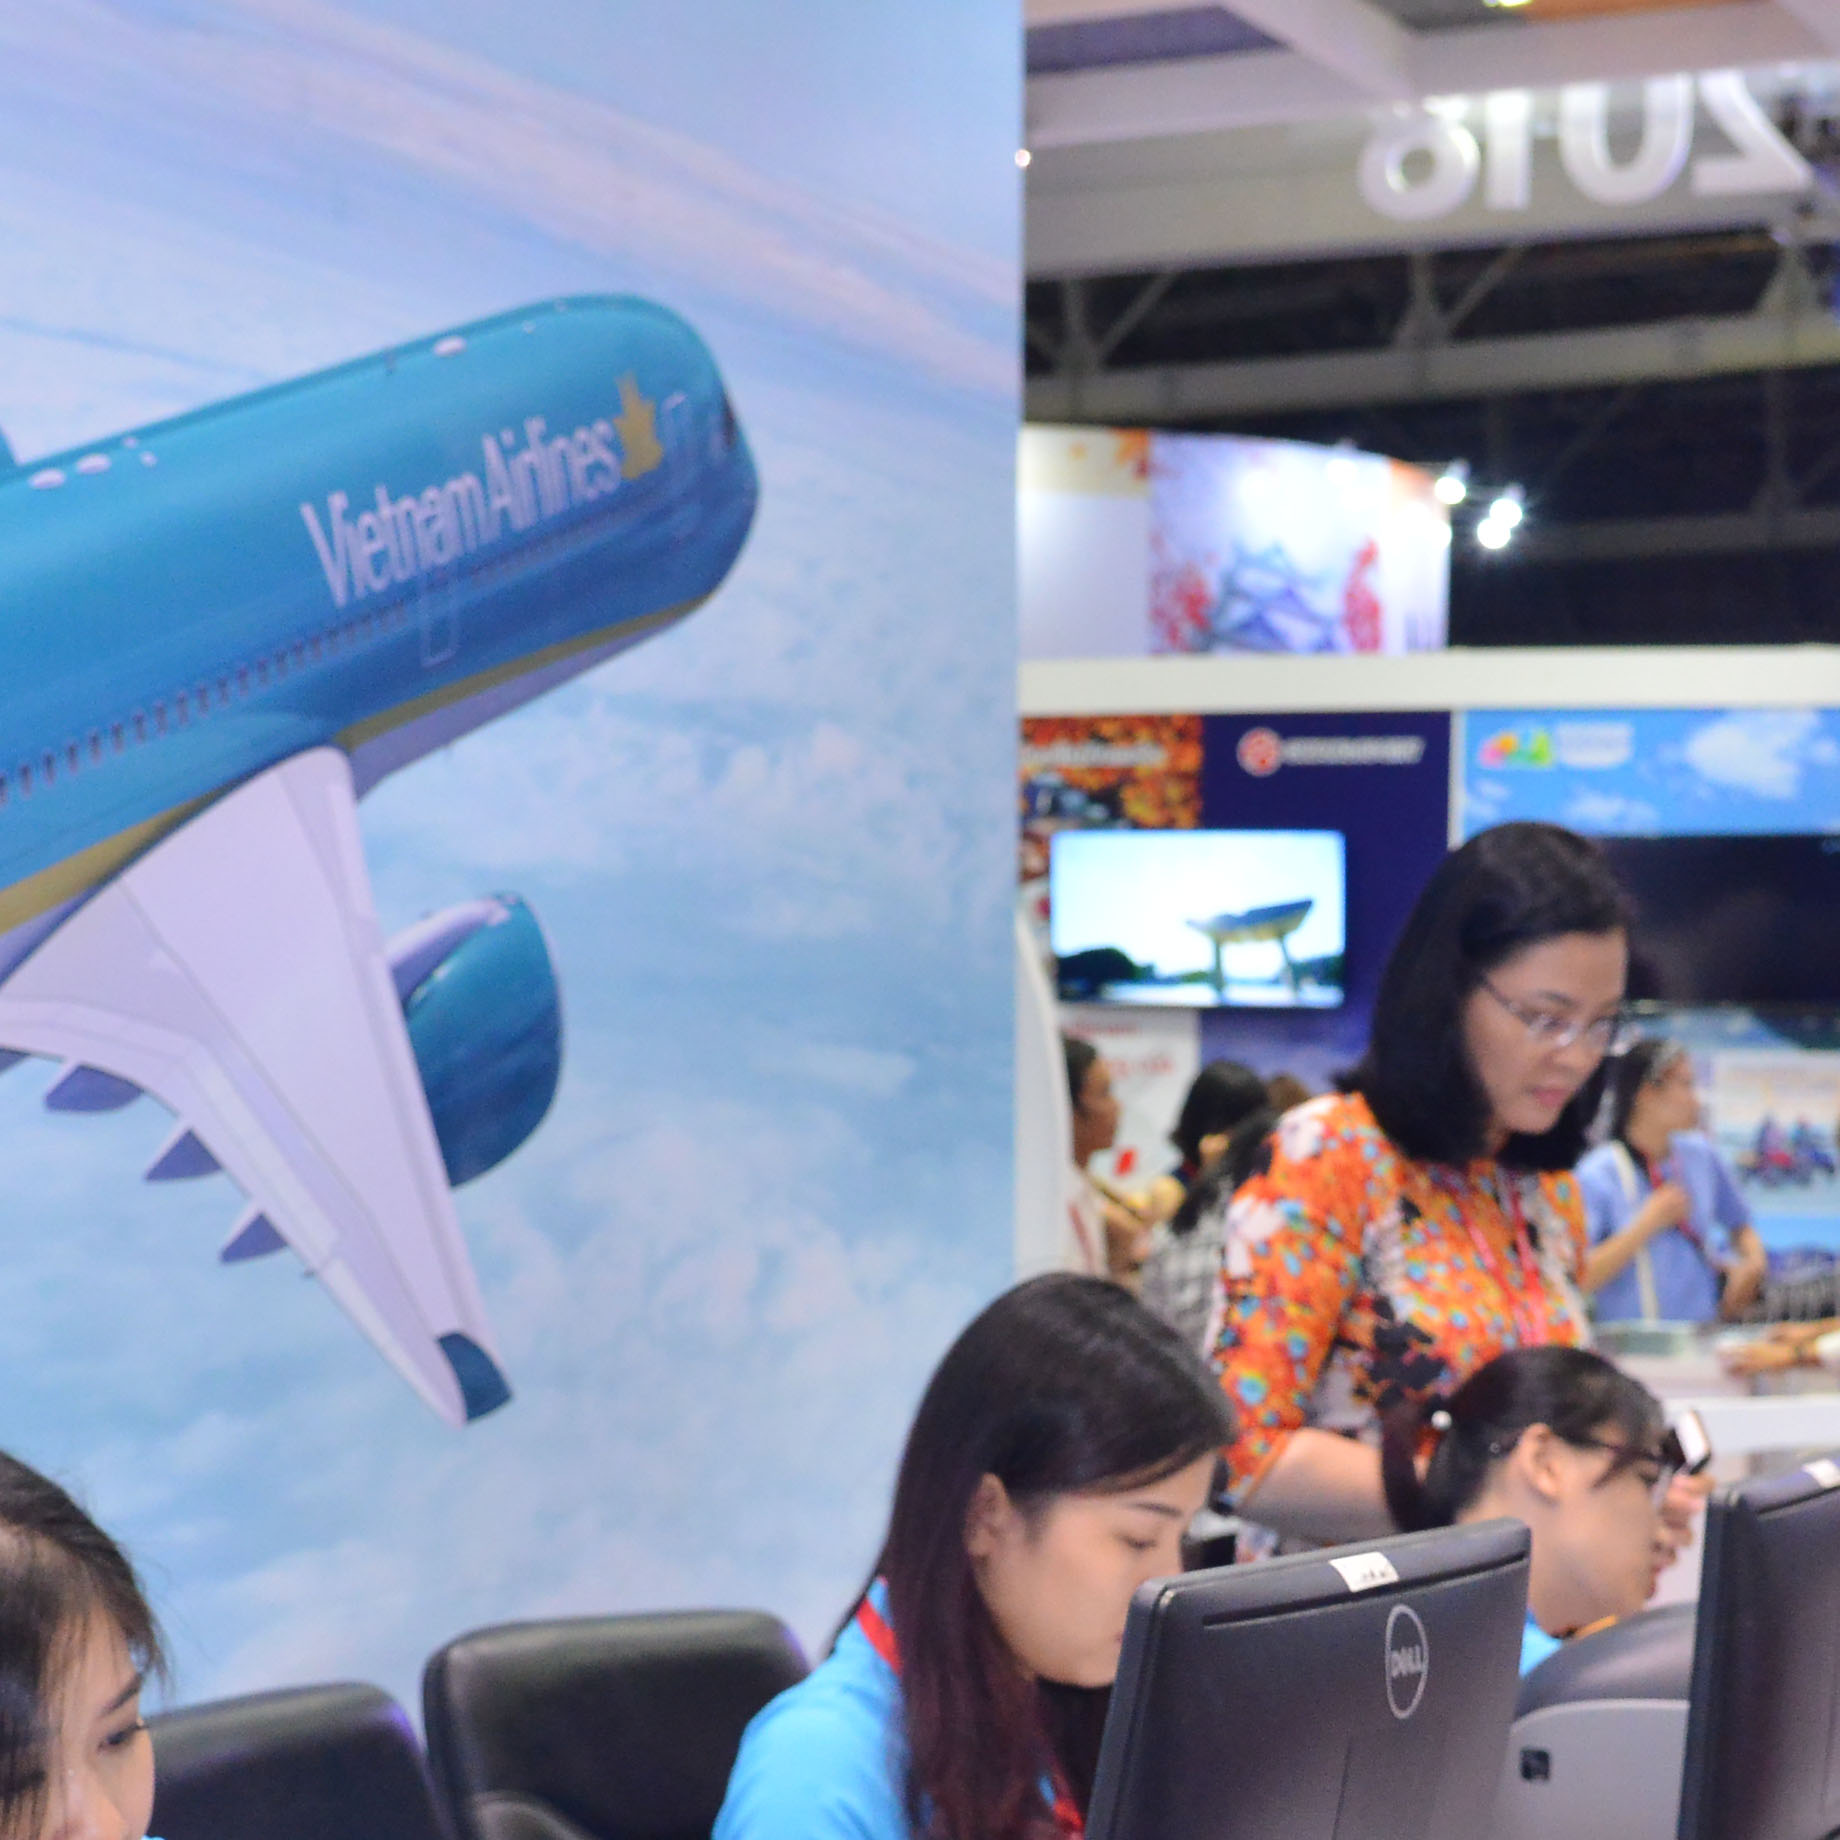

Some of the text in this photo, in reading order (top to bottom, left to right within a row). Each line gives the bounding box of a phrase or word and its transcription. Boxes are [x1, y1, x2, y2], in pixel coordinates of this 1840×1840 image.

[300, 416, 623, 607] Vietnam Airlines
[1389, 1643, 1424, 1680] DELL
